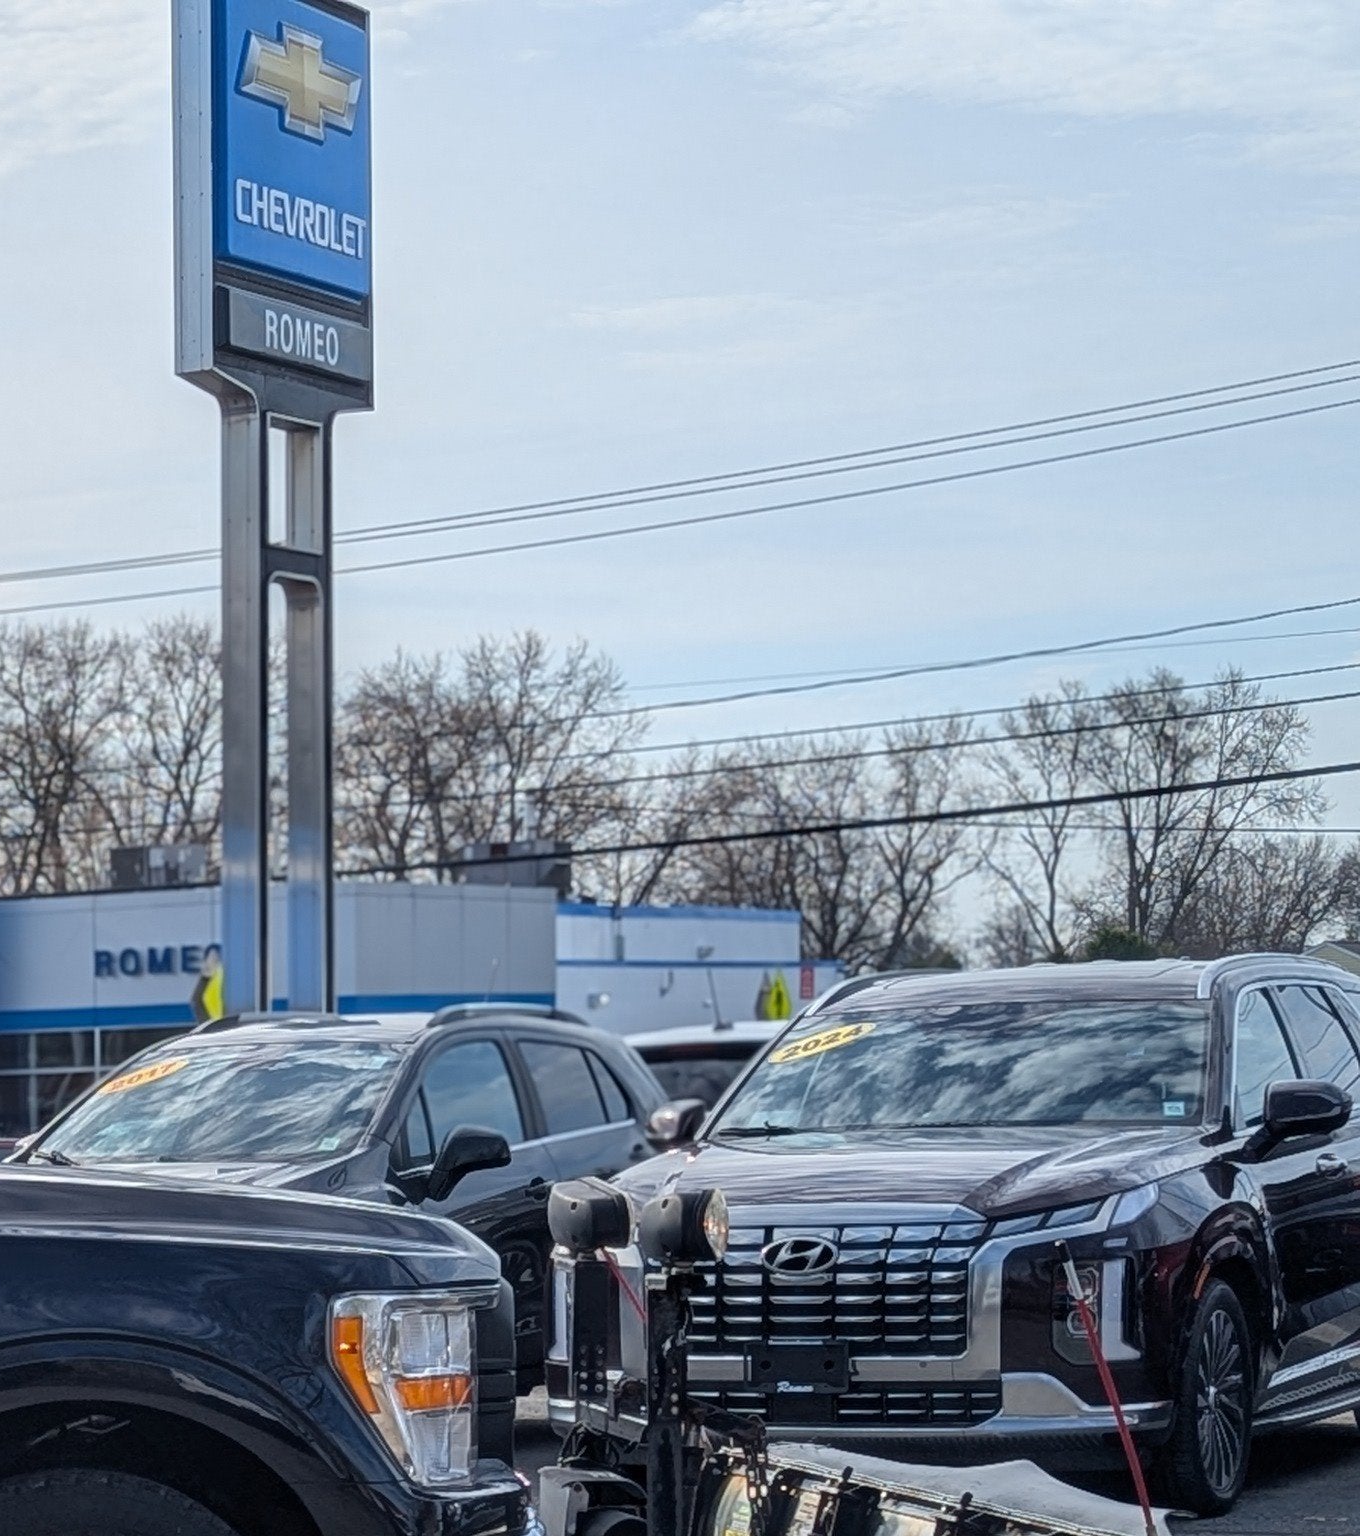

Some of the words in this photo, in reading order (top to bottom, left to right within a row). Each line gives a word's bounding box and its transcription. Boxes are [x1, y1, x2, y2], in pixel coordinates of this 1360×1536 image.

[235, 179, 366, 259] CHEVROLET
[265, 309, 339, 366] ROMEO
[780, 1026, 863, 1061] 2024
